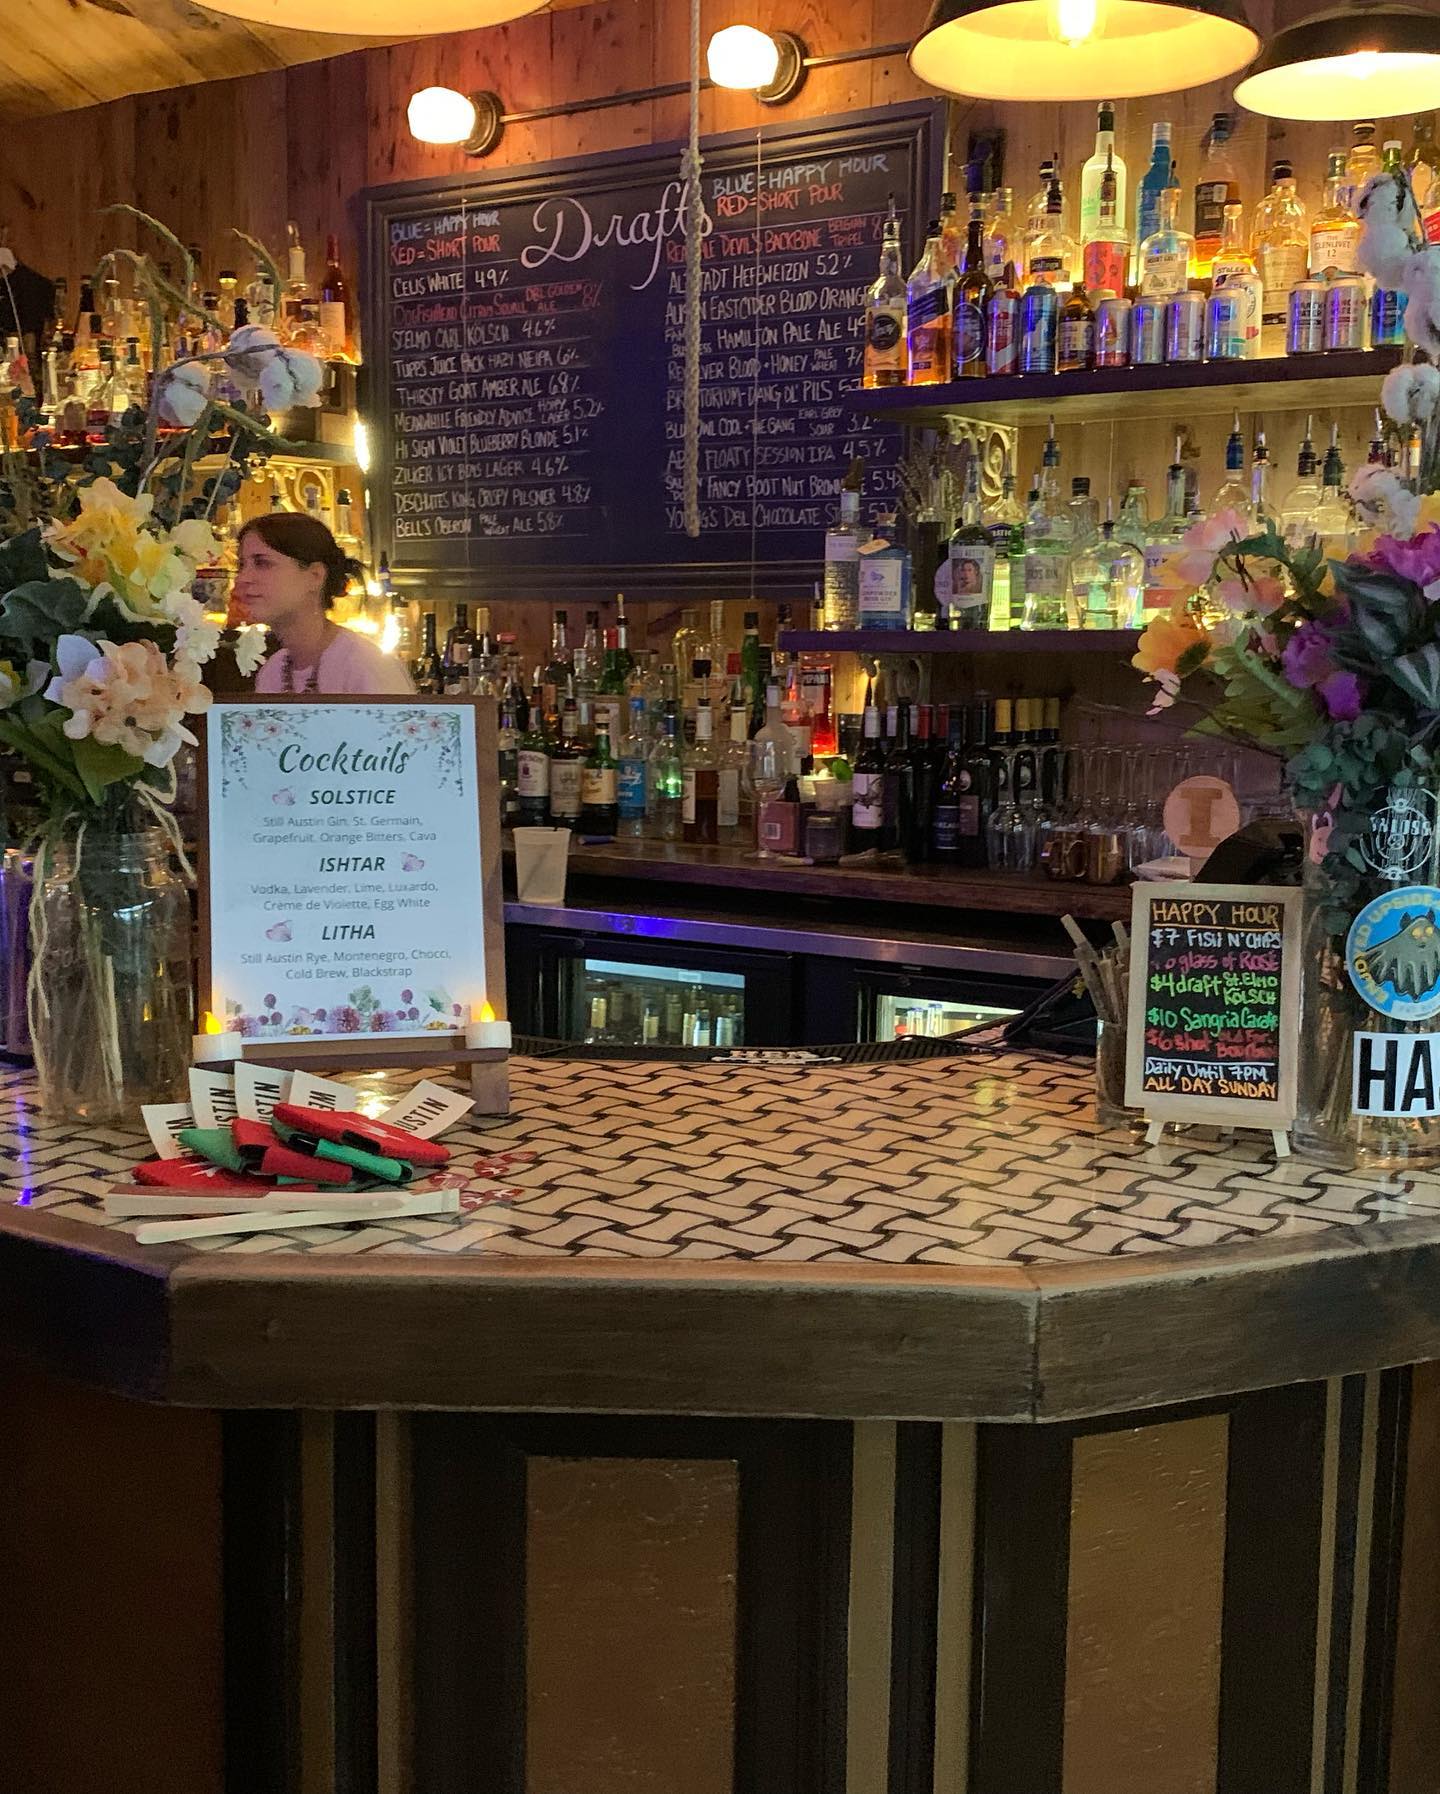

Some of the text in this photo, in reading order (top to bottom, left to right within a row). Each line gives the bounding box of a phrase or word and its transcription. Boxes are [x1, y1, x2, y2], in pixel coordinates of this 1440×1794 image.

[839, 154, 889, 178] HOUR
[808, 183, 844, 205] POUR
[472, 234, 500, 254] POUR
[427, 272, 464, 292] WHITE
[783, 321, 813, 344] PALE
[817, 318, 842, 341] ALE
[803, 380, 832, 402] PILS
[279, 742, 409, 774] Cocktails
[310, 790, 396, 805] SOLSTICE
[263, 816, 284, 827] Still
[288, 816, 325, 827] Austin
[319, 832, 362, 845] Orange
[409, 831, 437, 841] Cava
[319, 857, 385, 872] ISHTAR
[306, 900, 320, 910] de
[374, 898, 394, 911] Egg
[397, 898, 431, 908] White
[1153, 902, 1279, 926] HAPPY HOUR
[322, 925, 375, 940] LITHA
[1151, 929, 1180, 948] $7
[1187, 930, 1222, 948] FISH
[241, 953, 262, 964] Still
[266, 952, 302, 964] Austin
[1180, 951, 1218, 974] glass
[286, 968, 312, 980] Cold
[352, 967, 412, 979] Blackstrap
[1150, 972, 1175, 997] $4
[1176, 973, 1222, 997] draft
[1147, 1007, 1178, 1028] $10
[1180, 1007, 1239, 1037] Sangria
[1145, 1059, 1268, 1081] Daily Until 7PM
[1145, 1077, 1276, 1099] ALL DAY SUNDAY
